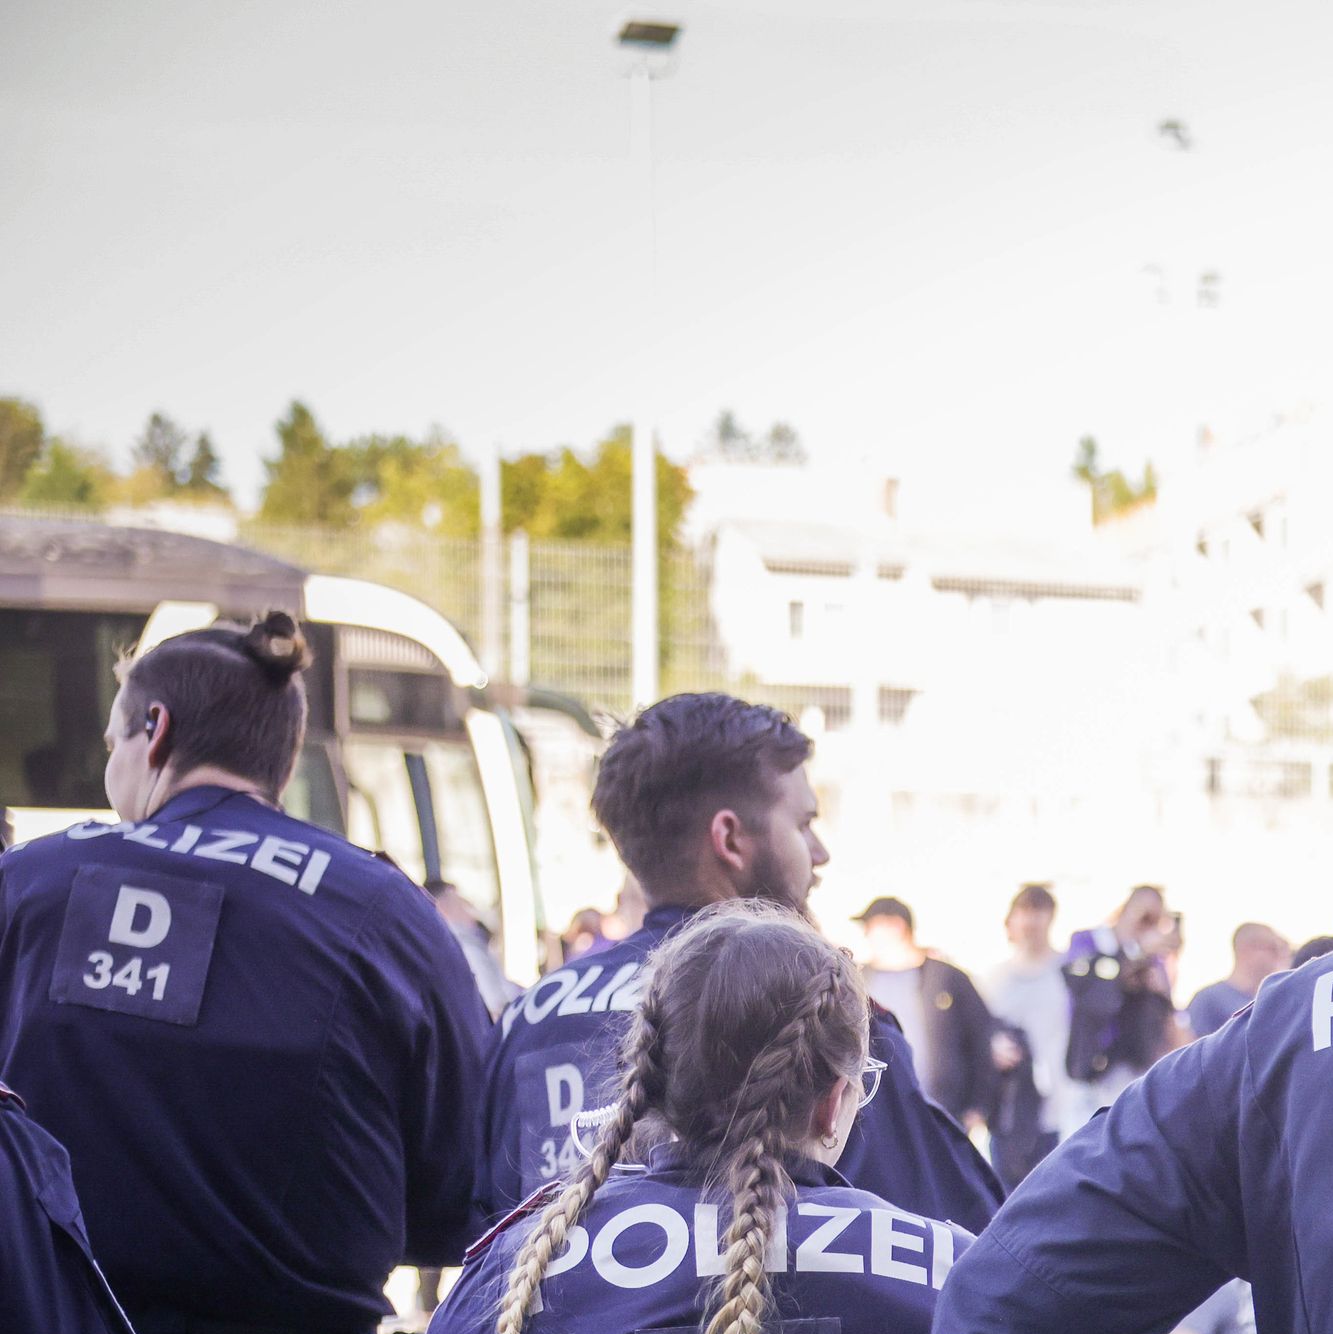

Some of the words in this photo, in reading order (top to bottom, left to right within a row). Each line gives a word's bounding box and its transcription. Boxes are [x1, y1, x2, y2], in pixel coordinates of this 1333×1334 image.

[10, 820, 331, 896] OLIZEI
[108, 884, 171, 948] D
[83, 951, 170, 1001] 341
[545, 1063, 584, 1127] D
